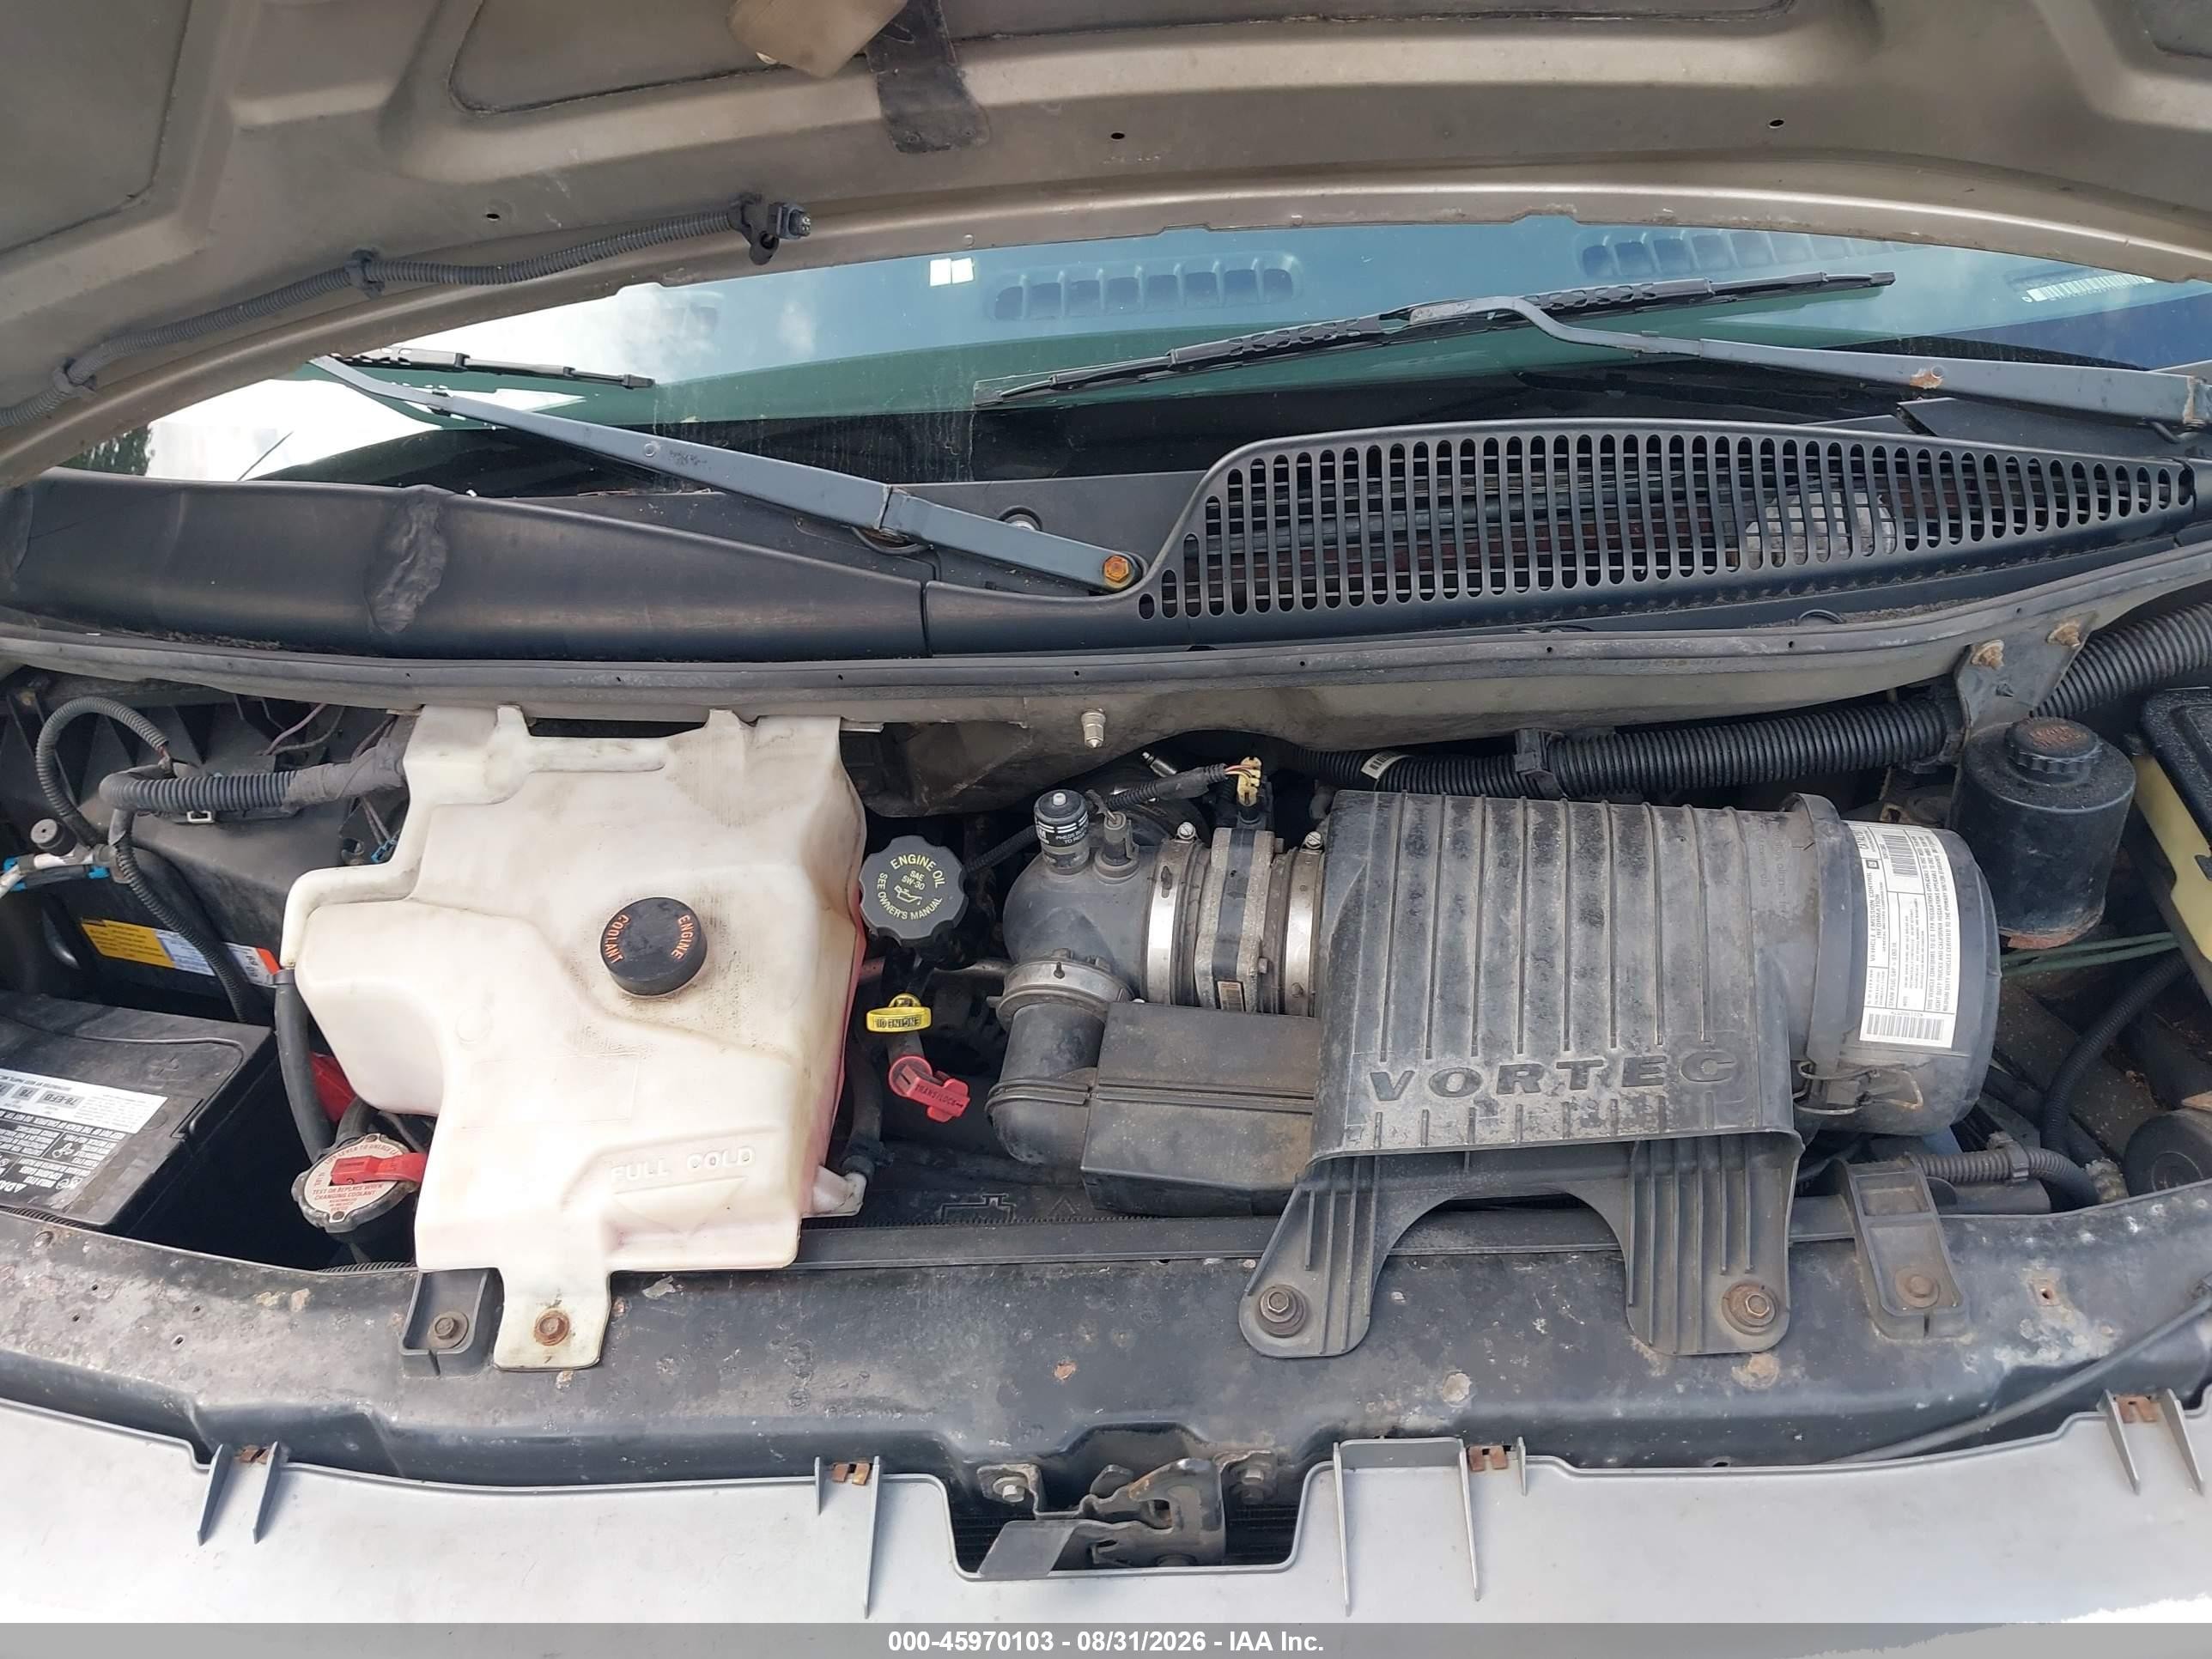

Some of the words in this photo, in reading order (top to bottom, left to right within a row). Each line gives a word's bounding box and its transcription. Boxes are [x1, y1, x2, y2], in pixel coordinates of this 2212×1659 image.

[877, 872, 888, 890] SEE
[890, 854, 937, 872] ENGINE
[933, 870, 945, 888] OIL
[902, 875, 926, 890] 5W-30
[910, 871, 925, 881] SAE
[878, 891, 908, 920] OWNER'S
[910, 897, 943, 920] MANUAL
[605, 915, 629, 963] COOLANT
[672, 915, 695, 960] ENGINE
[1369, 1050, 1736, 1102] VORTEC
[611, 1158, 671, 1182] FULL
[686, 1146, 756, 1171] COLD
